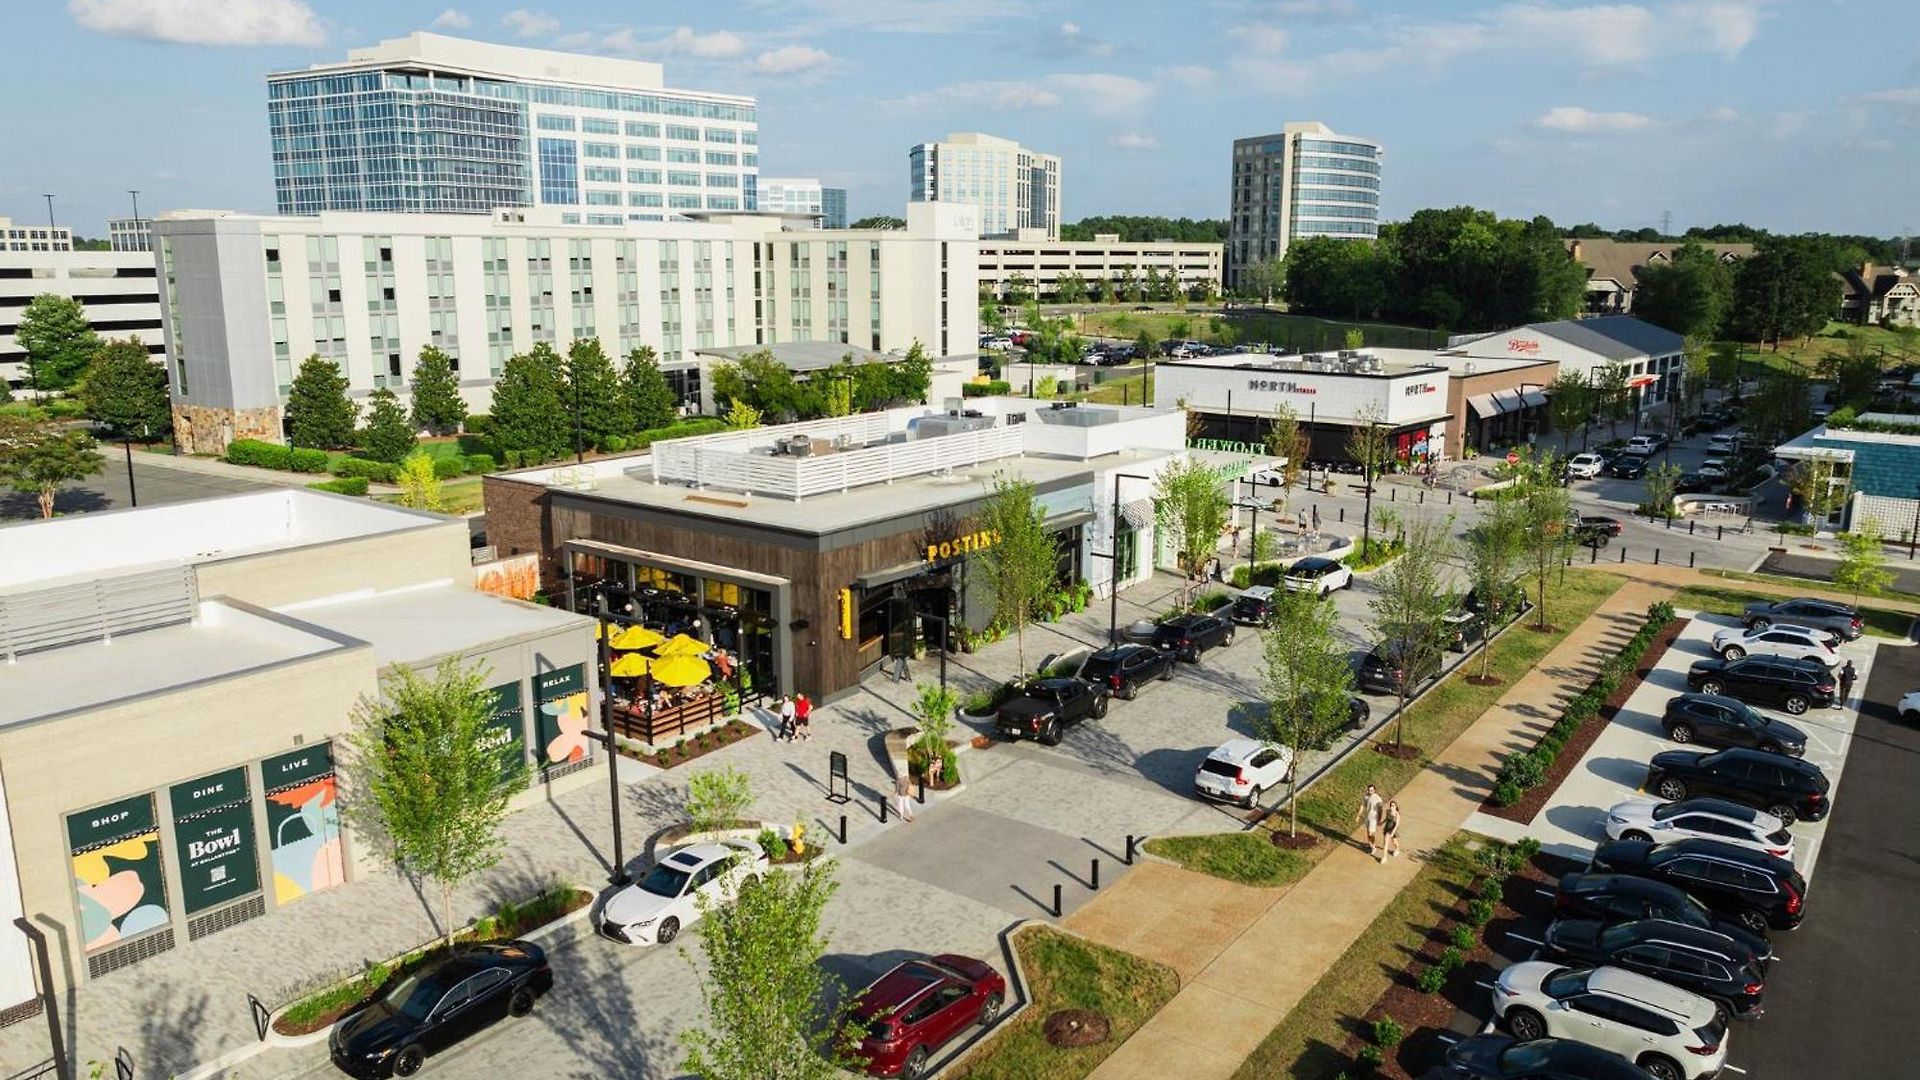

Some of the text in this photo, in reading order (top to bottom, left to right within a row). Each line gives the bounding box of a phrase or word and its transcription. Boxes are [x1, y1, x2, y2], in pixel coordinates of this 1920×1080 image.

[1248, 380, 1297, 393] NORTH
[542, 675, 571, 688] RELAX
[281, 758, 309, 772] LIVE
[193, 783, 225, 799] DINE
[91, 811, 130, 828] SHOP
[205, 827, 223, 837] THE
[188, 827, 241, 861] Bowl
